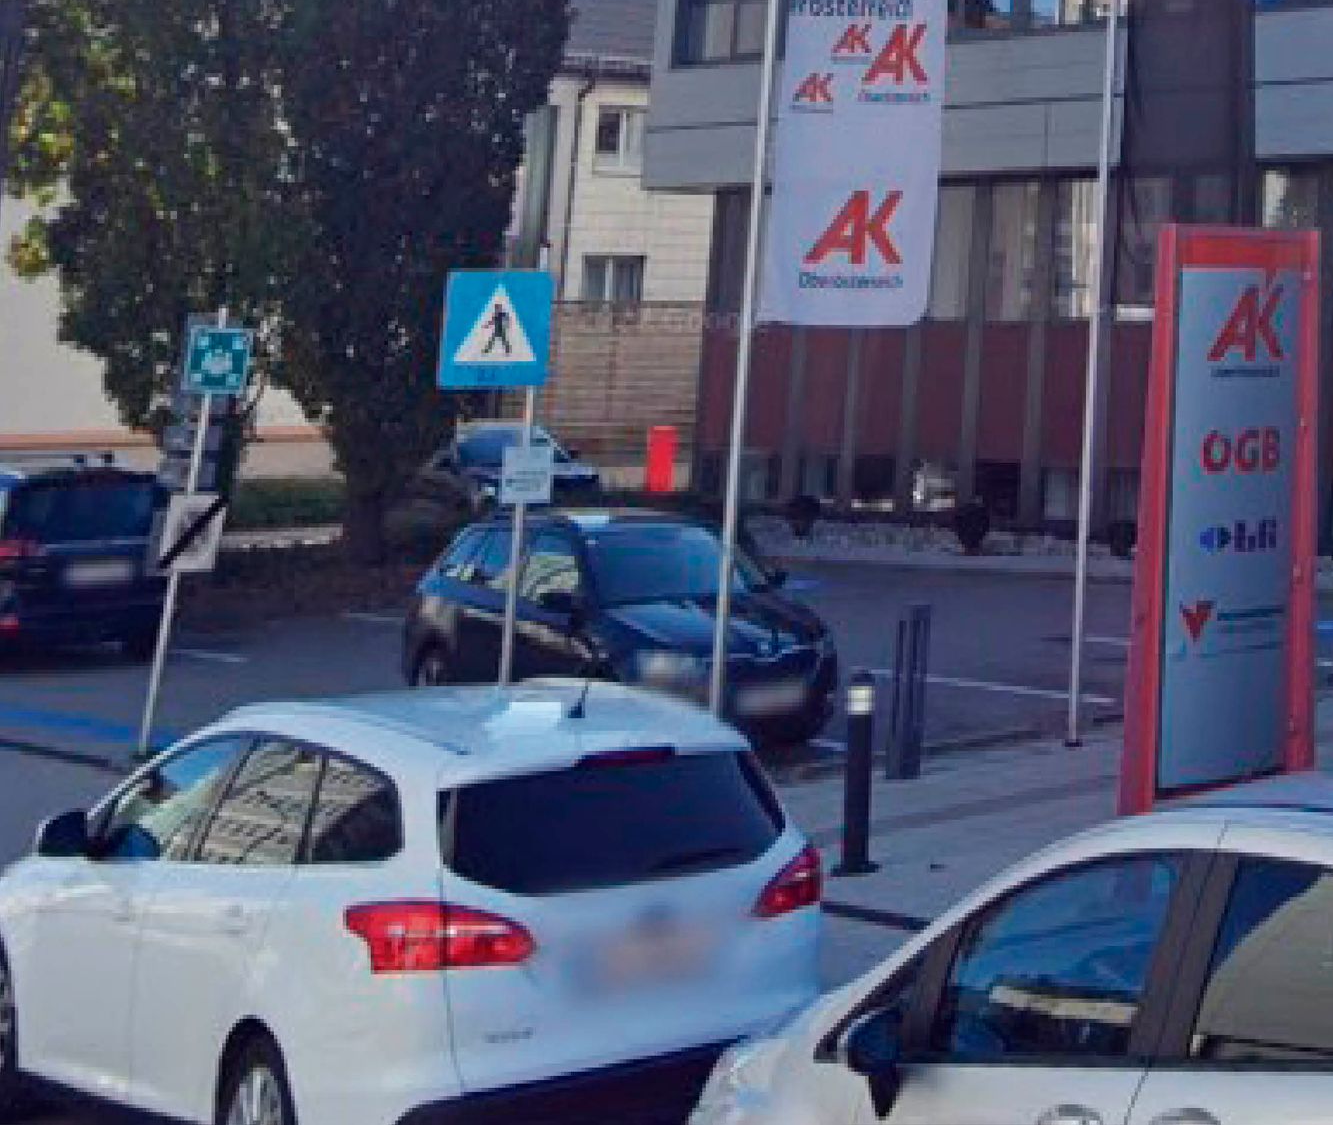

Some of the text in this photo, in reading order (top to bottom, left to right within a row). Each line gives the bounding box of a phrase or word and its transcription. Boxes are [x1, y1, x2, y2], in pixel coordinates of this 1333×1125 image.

[832, 25, 872, 54] AK
[862, 25, 928, 84] AK
[793, 74, 834, 102] AK
[802, 190, 904, 264] AK
[1207, 286, 1284, 362] AK
